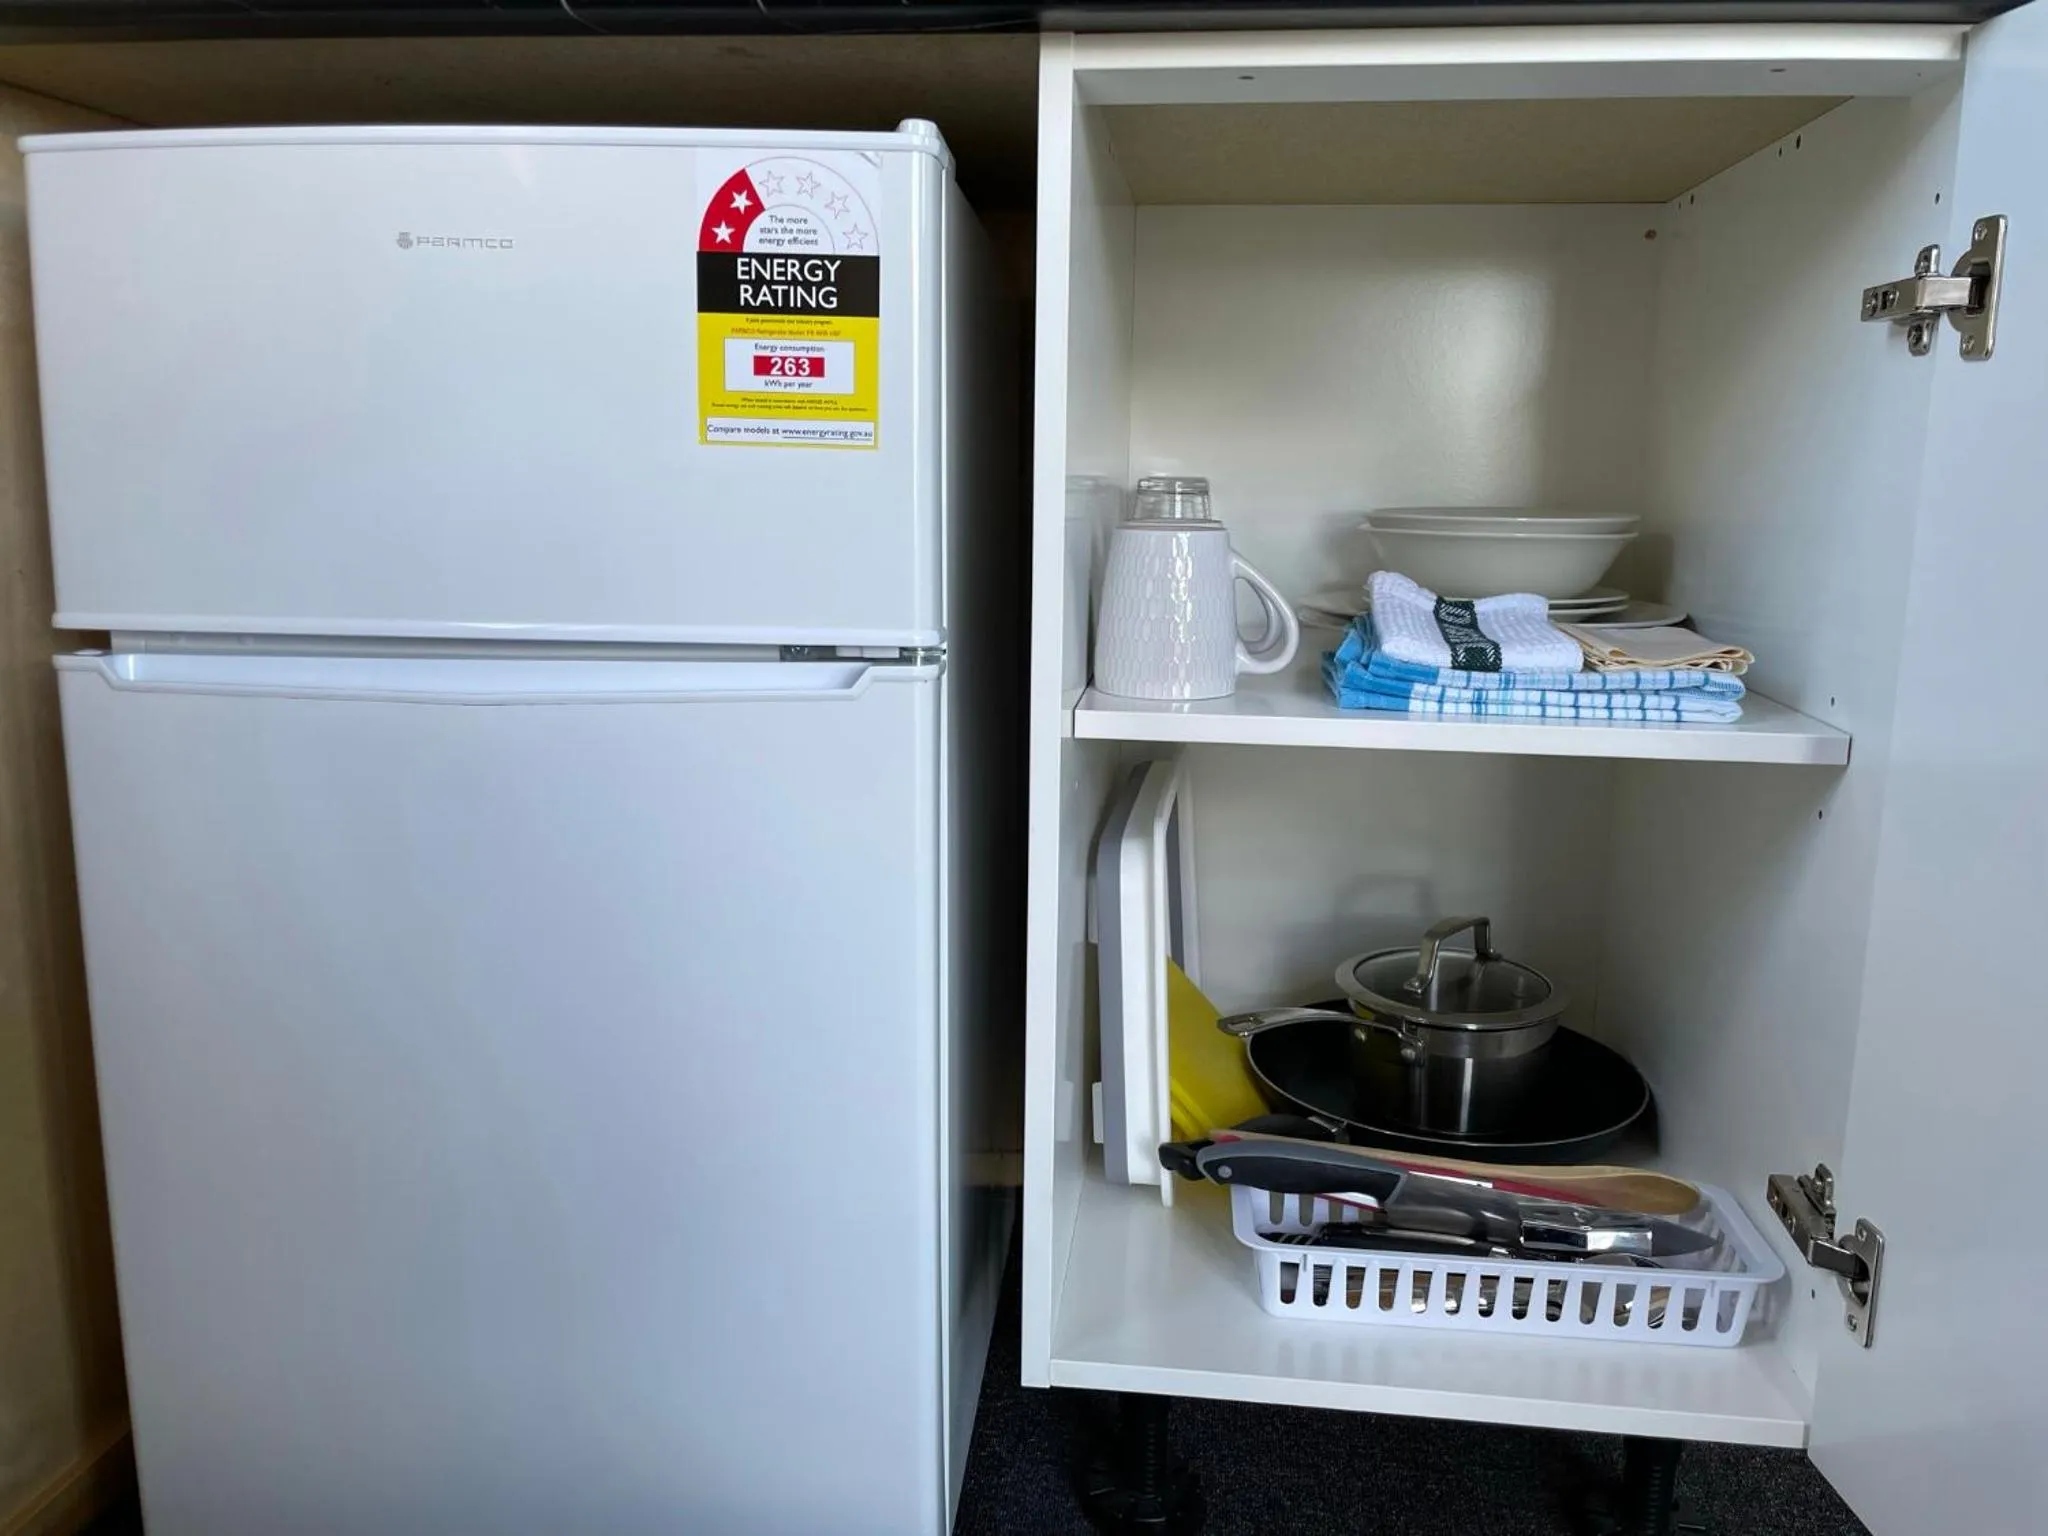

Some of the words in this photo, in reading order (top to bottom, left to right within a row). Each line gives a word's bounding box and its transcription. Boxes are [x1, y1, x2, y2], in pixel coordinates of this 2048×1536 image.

[769, 215, 784, 224] The
[786, 217, 808, 225] more
[759, 227, 778, 235] stars
[781, 226, 794, 235] the
[796, 228, 818, 236] more
[759, 238, 785, 246] energy
[787, 236, 819, 246] efficient
[737, 257, 841, 282] ENERGY
[739, 284, 838, 309] RATING
[754, 342, 777, 353] Energy
[779, 344, 825, 354] consumption
[770, 357, 811, 377] 263
[783, 382, 796, 390] per
[797, 382, 813, 390] year
[706, 423, 741, 435] Compare
[743, 426, 770, 436] models
[771, 428, 781, 436] at
[782, 430, 873, 440] www.energyrating.gov.au
